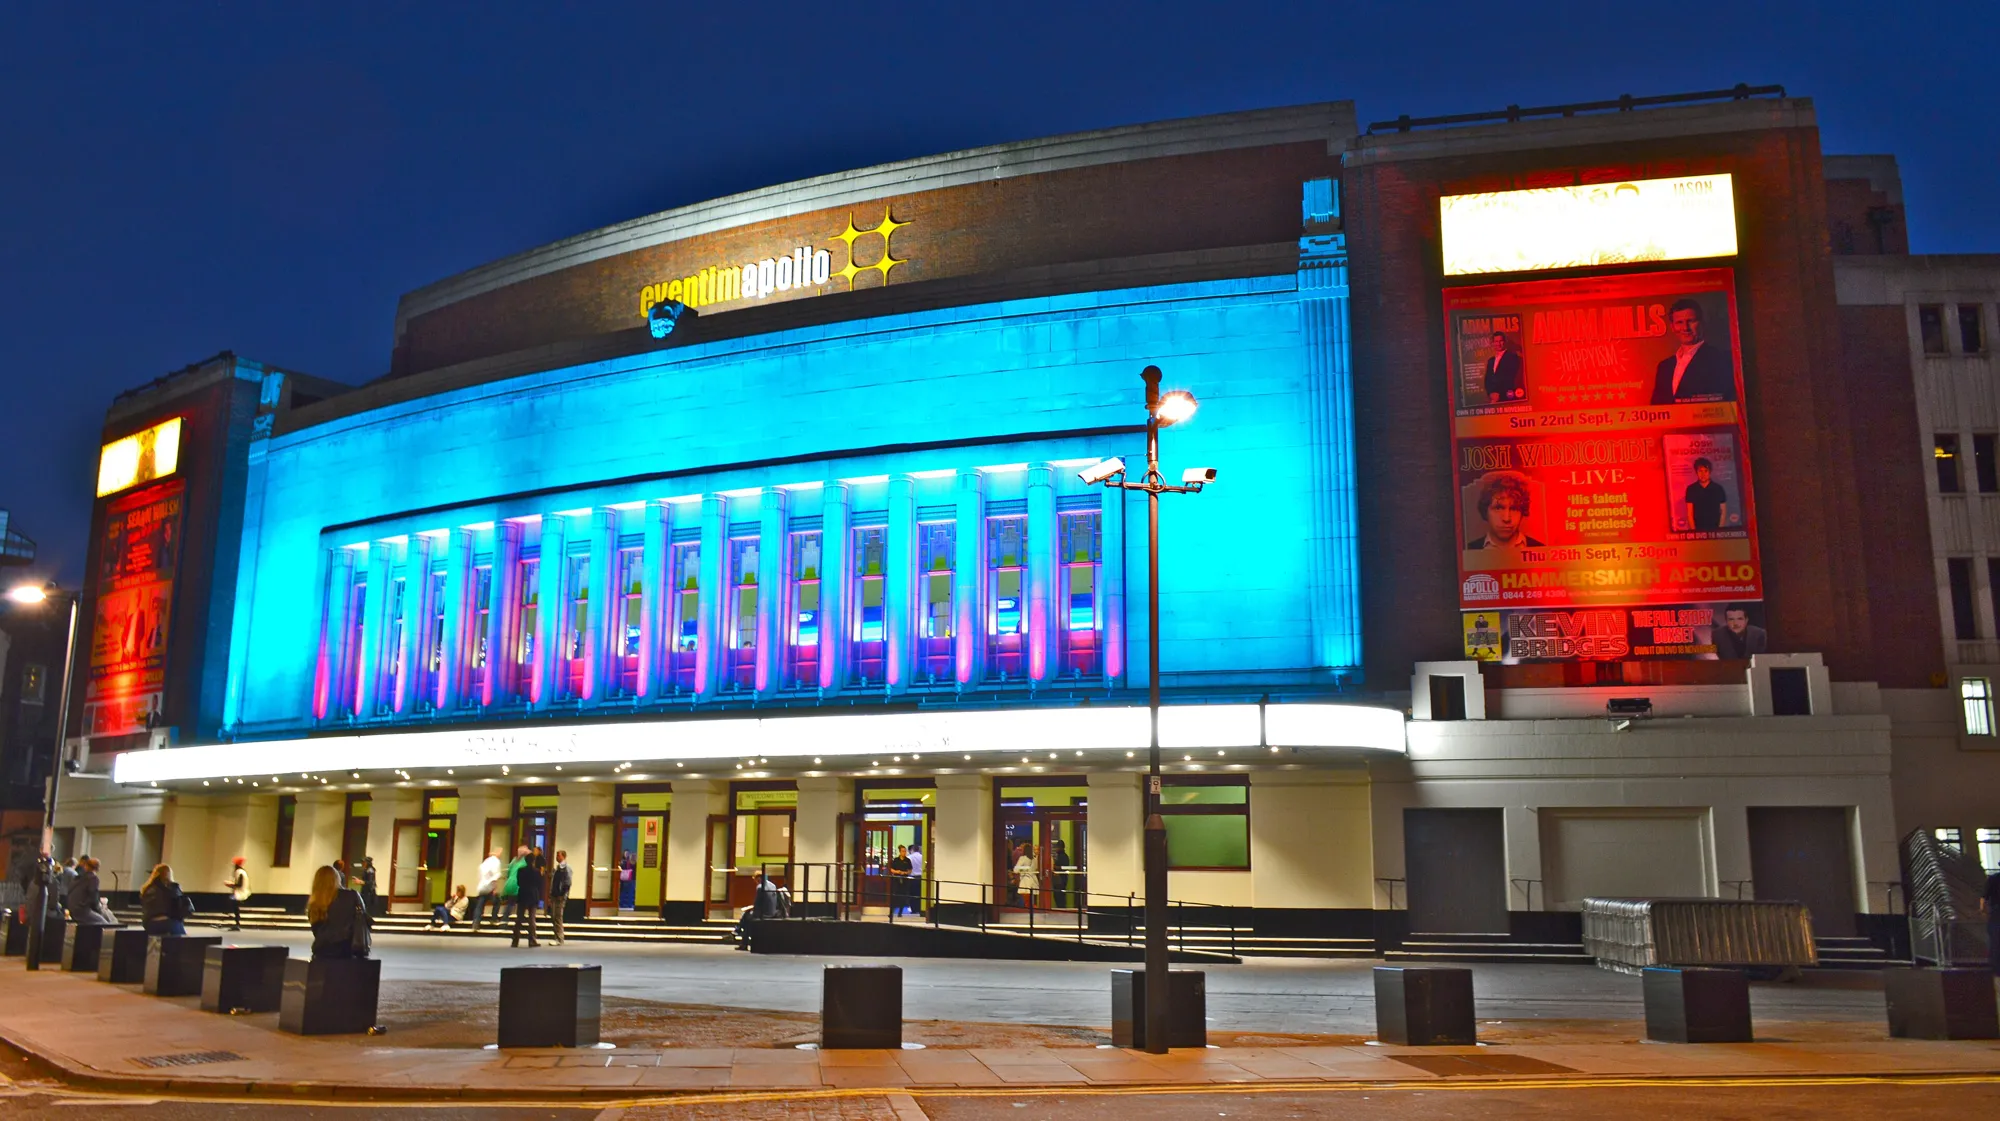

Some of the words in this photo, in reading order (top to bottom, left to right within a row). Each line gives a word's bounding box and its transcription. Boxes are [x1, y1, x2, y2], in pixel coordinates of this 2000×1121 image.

[1532, 308, 1598, 344] ADAM
[1602, 303, 1667, 340] HILLS
[1560, 344, 1619, 373] HAPPYISM
[1510, 416, 1536, 428] Sun
[1540, 414, 1574, 427] 22nd
[1578, 412, 1613, 426] Sept,
[1618, 410, 1671, 423] 7.30pm
[1460, 444, 1512, 471] JOSH
[1516, 438, 1657, 468] WIDDICOMBE
[1593, 492, 1628, 504] talent
[1566, 507, 1584, 517] for
[1586, 505, 1634, 518] comedy
[1566, 520, 1576, 530] is
[1520, 550, 1546, 562] Thu
[1550, 548, 1580, 560] 26th
[1585, 547, 1620, 561] Sept,
[1625, 546, 1678, 559] 7.30pm
[1502, 568, 1660, 588] HAMMERSMITH
[1669, 565, 1754, 583] APOLLO
[1463, 580, 1499, 593] APOLLO
[1502, 591, 1524, 599] 0844
[1526, 590, 1542, 598] 249
[1508, 610, 1627, 638] KEVIN
[1632, 610, 1653, 628] THE
[1653, 610, 1678, 626] FULL
[1678, 609, 1713, 626] STORY
[1653, 626, 1694, 644] BOXSET
[1510, 636, 1629, 658] BRIDGES
